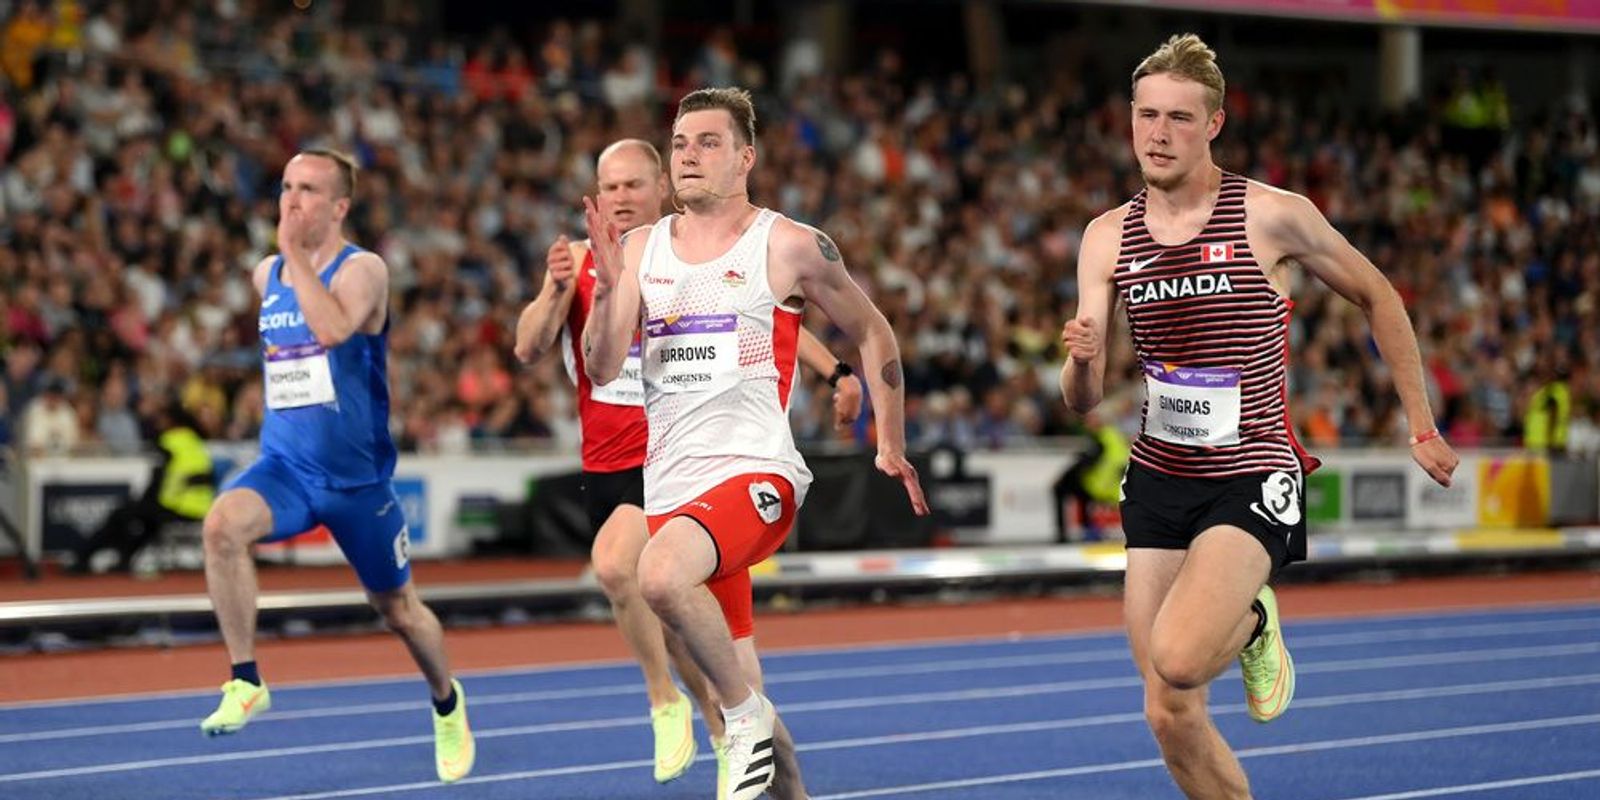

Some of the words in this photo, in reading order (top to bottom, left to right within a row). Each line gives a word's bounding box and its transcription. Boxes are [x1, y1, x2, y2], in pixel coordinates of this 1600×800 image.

[1129, 273, 1233, 304] CANADA
[1160, 395, 1211, 416] GINGRAS
[758, 491, 780, 512] 4
[1271, 476, 1294, 515] 3
